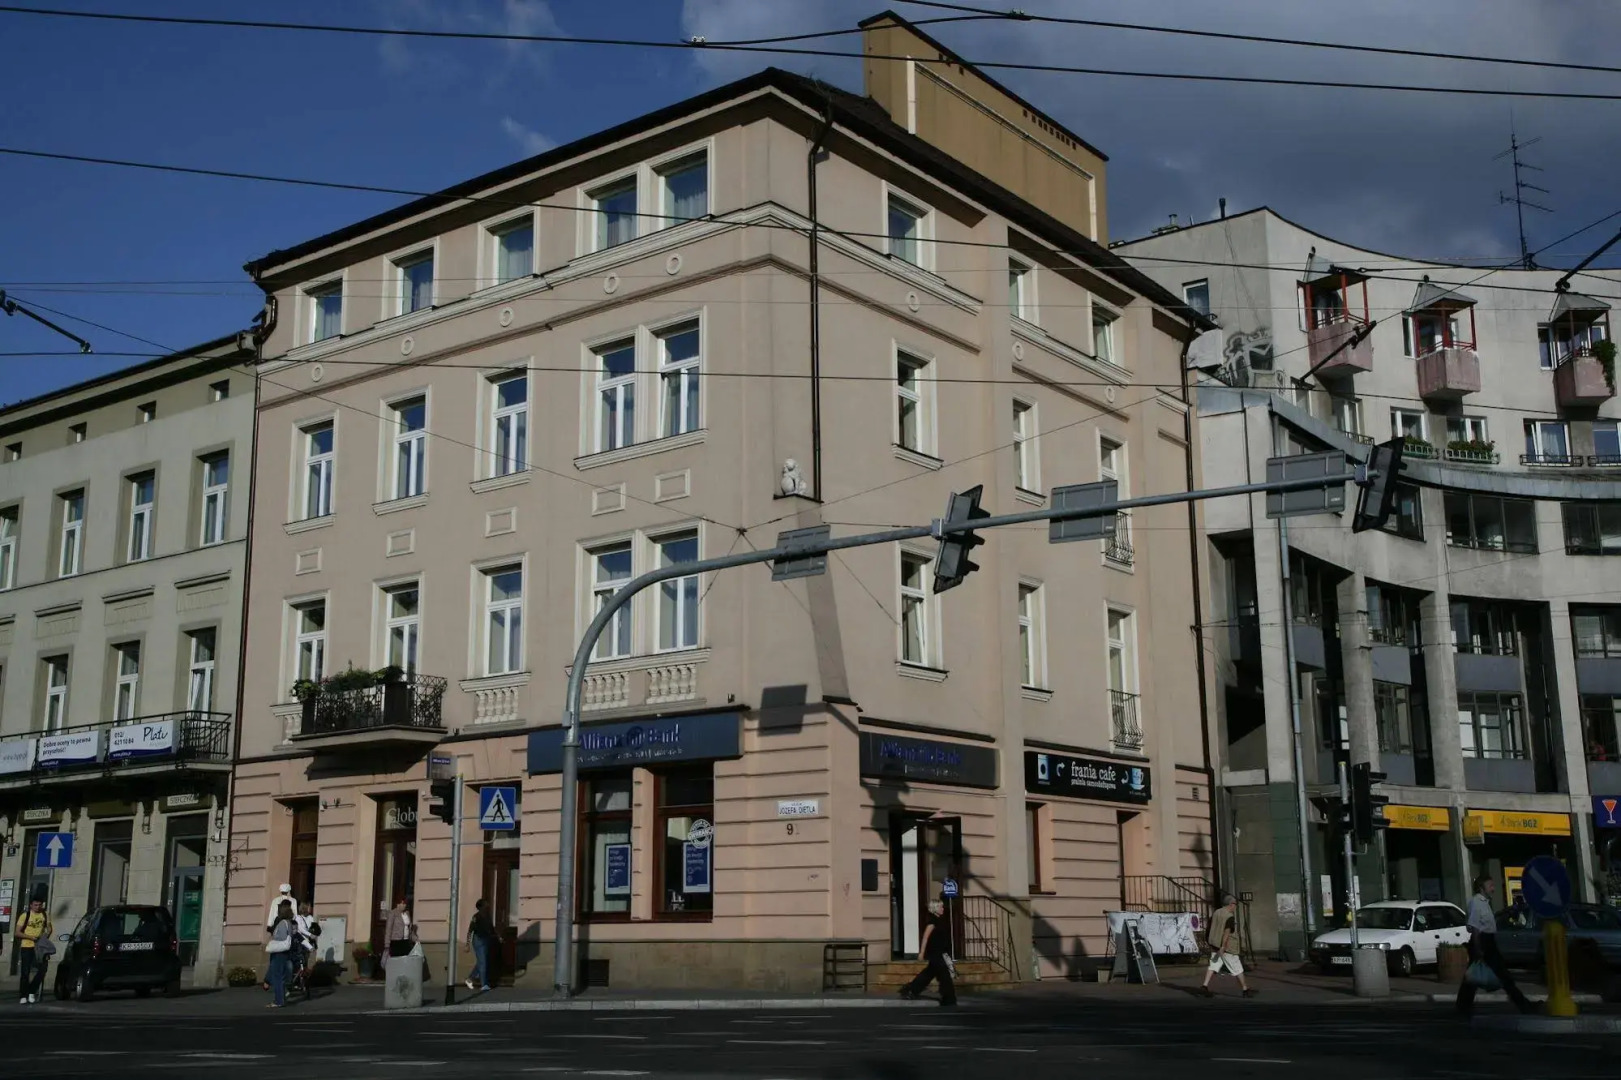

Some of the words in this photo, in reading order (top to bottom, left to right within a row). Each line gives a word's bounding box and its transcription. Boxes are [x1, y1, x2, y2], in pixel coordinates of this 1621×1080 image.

[1071, 760, 1097, 780] frania
[1098, 765, 1116, 781] cafe
[786, 823, 794, 836] 9
